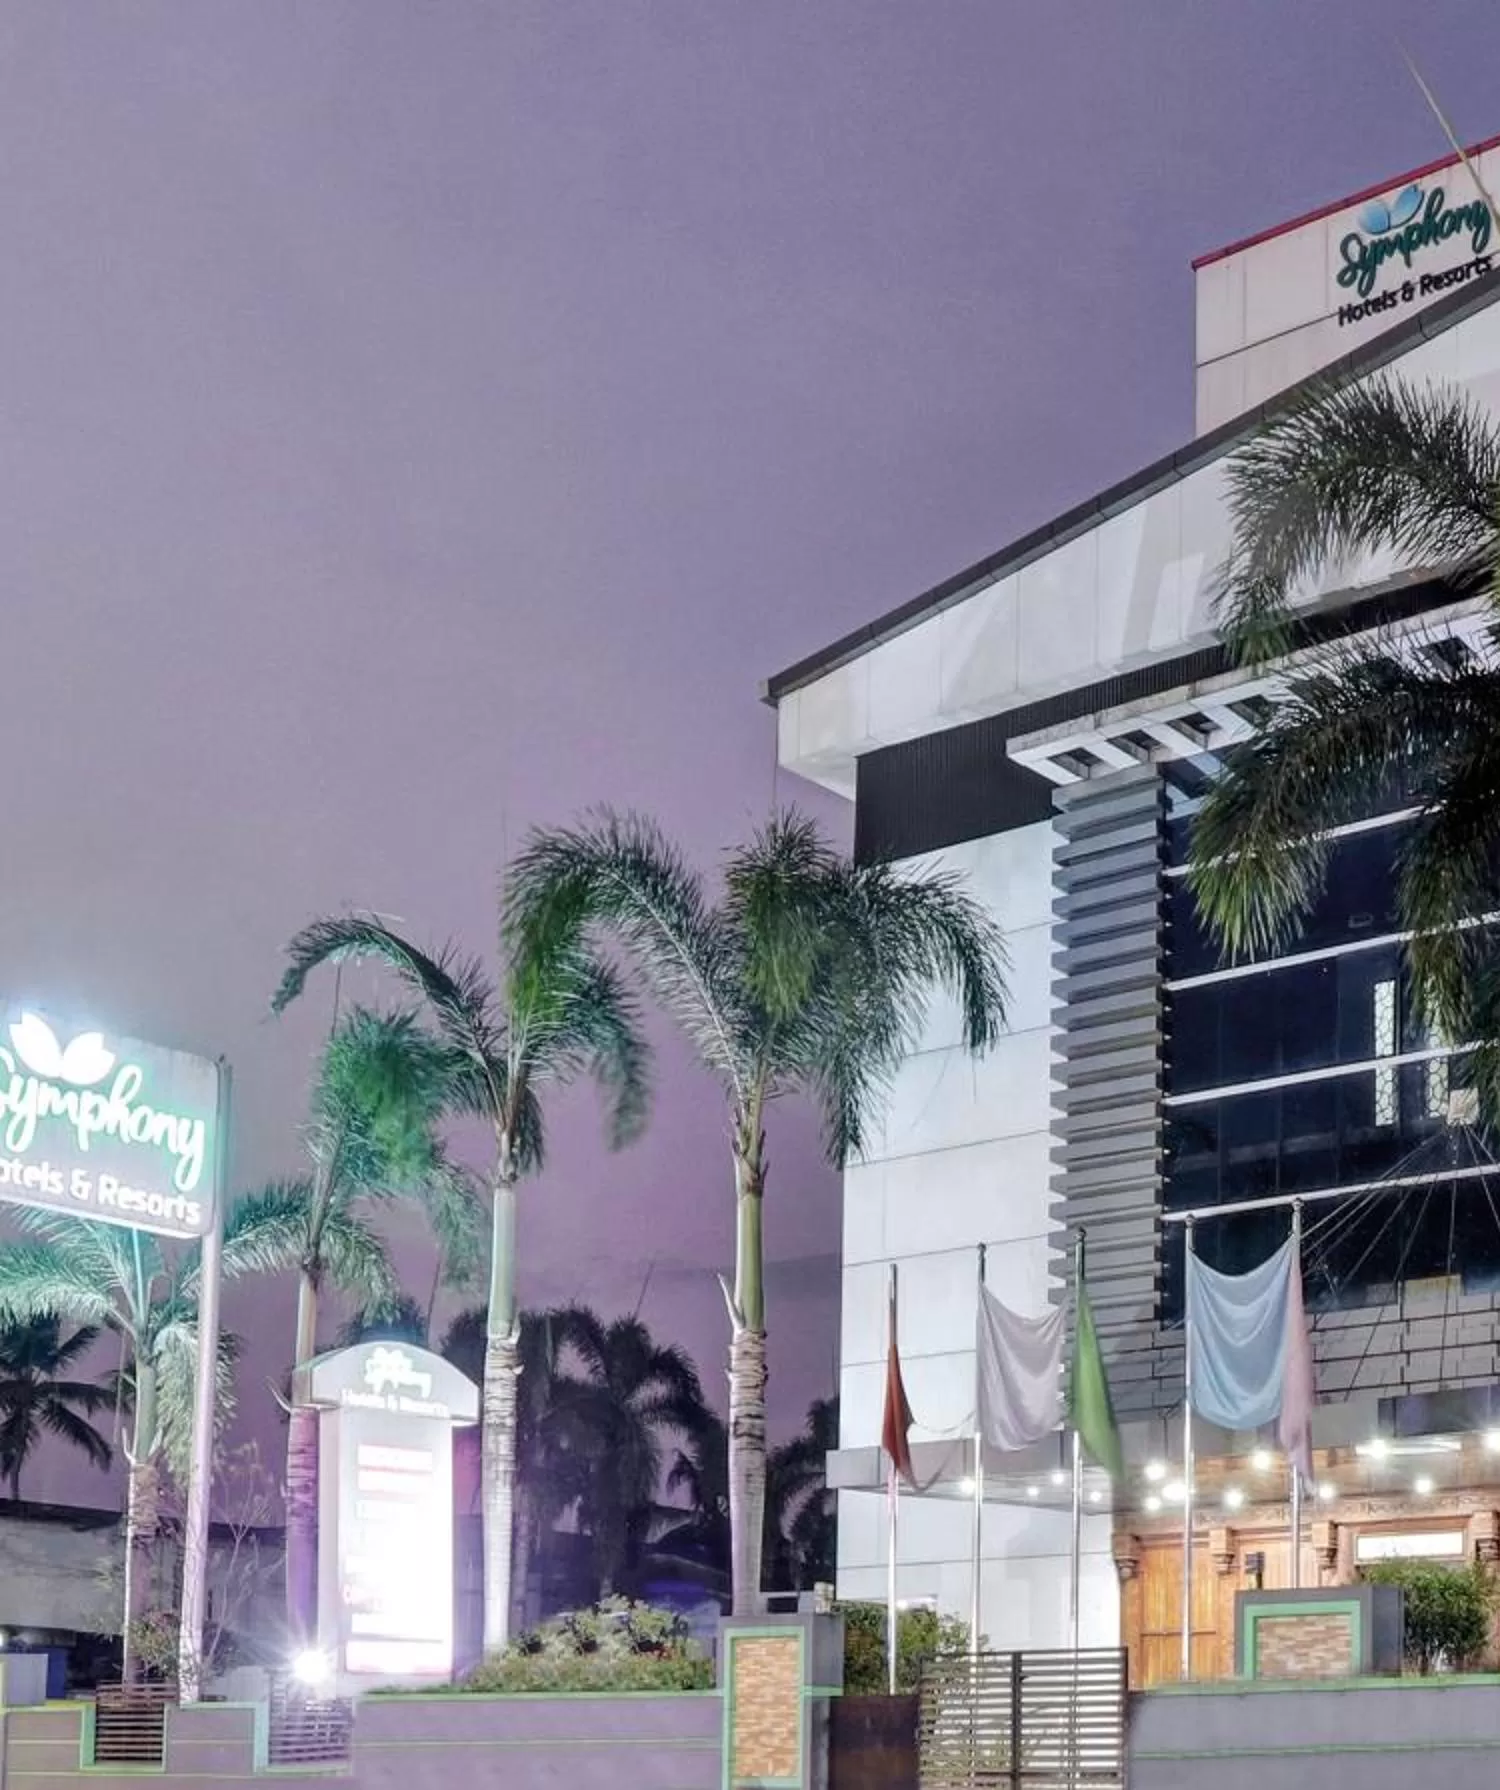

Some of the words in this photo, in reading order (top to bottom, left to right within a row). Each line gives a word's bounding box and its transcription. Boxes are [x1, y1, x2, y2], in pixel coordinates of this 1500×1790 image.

[1336, 186, 1491, 298] Symphony
[1338, 289, 1397, 327] Hotels
[1401, 280, 1415, 301] &
[1420, 255, 1493, 296] Resorts
[0, 1157, 64, 1195] otels
[70, 1168, 92, 1202] &
[98, 1173, 201, 1226] Resorts
